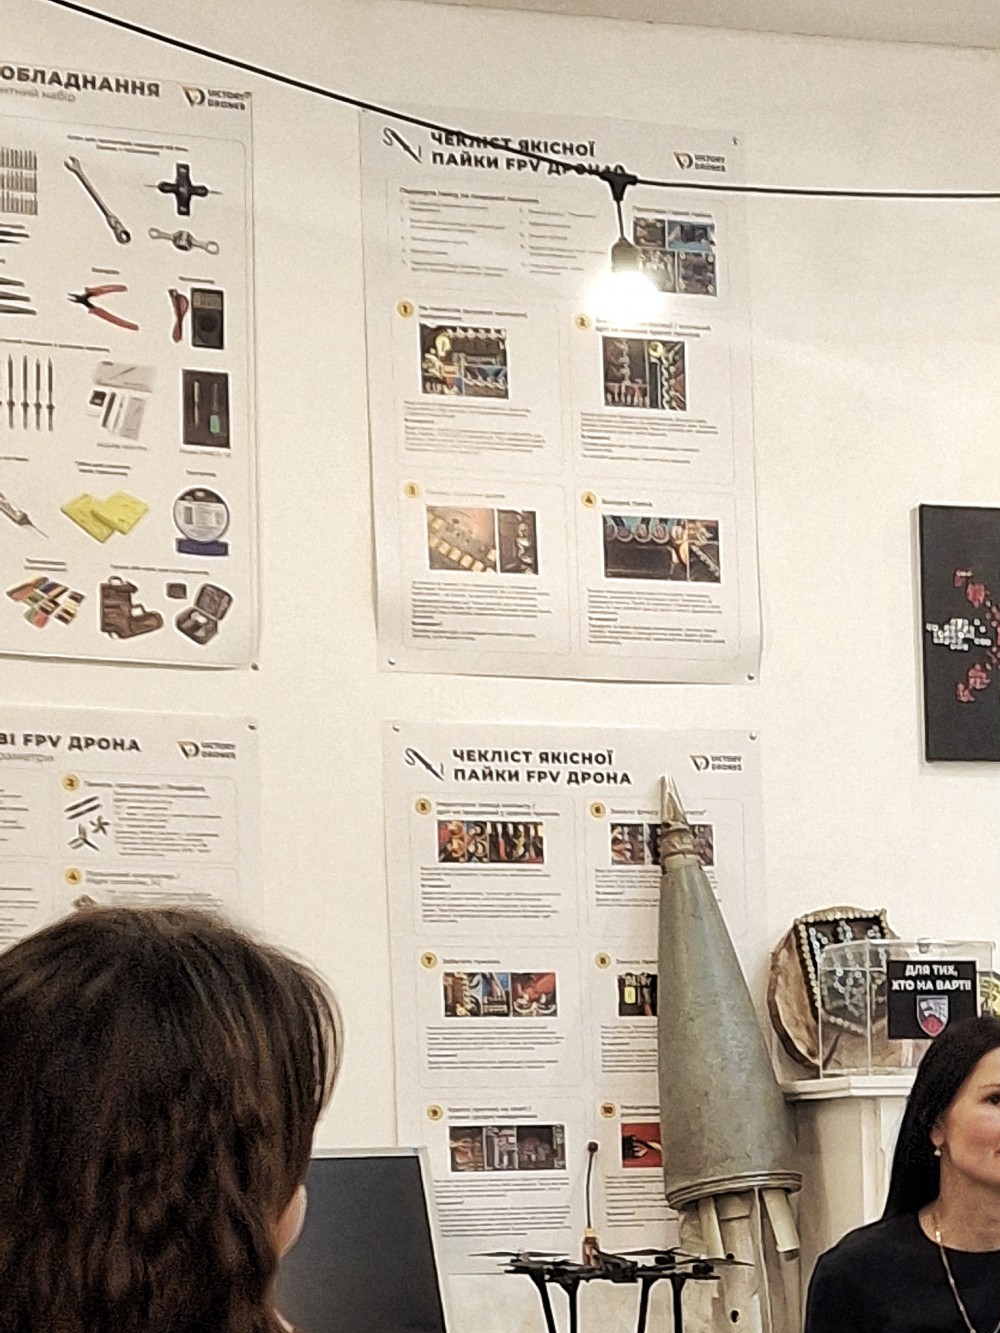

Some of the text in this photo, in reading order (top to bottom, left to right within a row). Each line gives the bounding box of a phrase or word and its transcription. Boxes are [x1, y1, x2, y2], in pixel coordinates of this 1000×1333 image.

[1, 65, 160, 97] ОБЛАДНАННЯ
[518, 140, 595, 157] ЯКІСНОЇ
[432, 151, 498, 169] ПАЙКИ
[506, 158, 540, 172] FPV
[23, 734, 61, 748] FPV
[68, 736, 141, 751] ДРОНА
[453, 749, 613, 765] ЧЕКЛІСТ ЯКІСНОЇ
[454, 766, 631, 785] ПАЙКИ FPV ДРОНА
[905, 964, 958, 977] ДЛЯ ТИХ,
[892, 980, 915, 991] ХТО
[917, 980, 934, 990] НА
